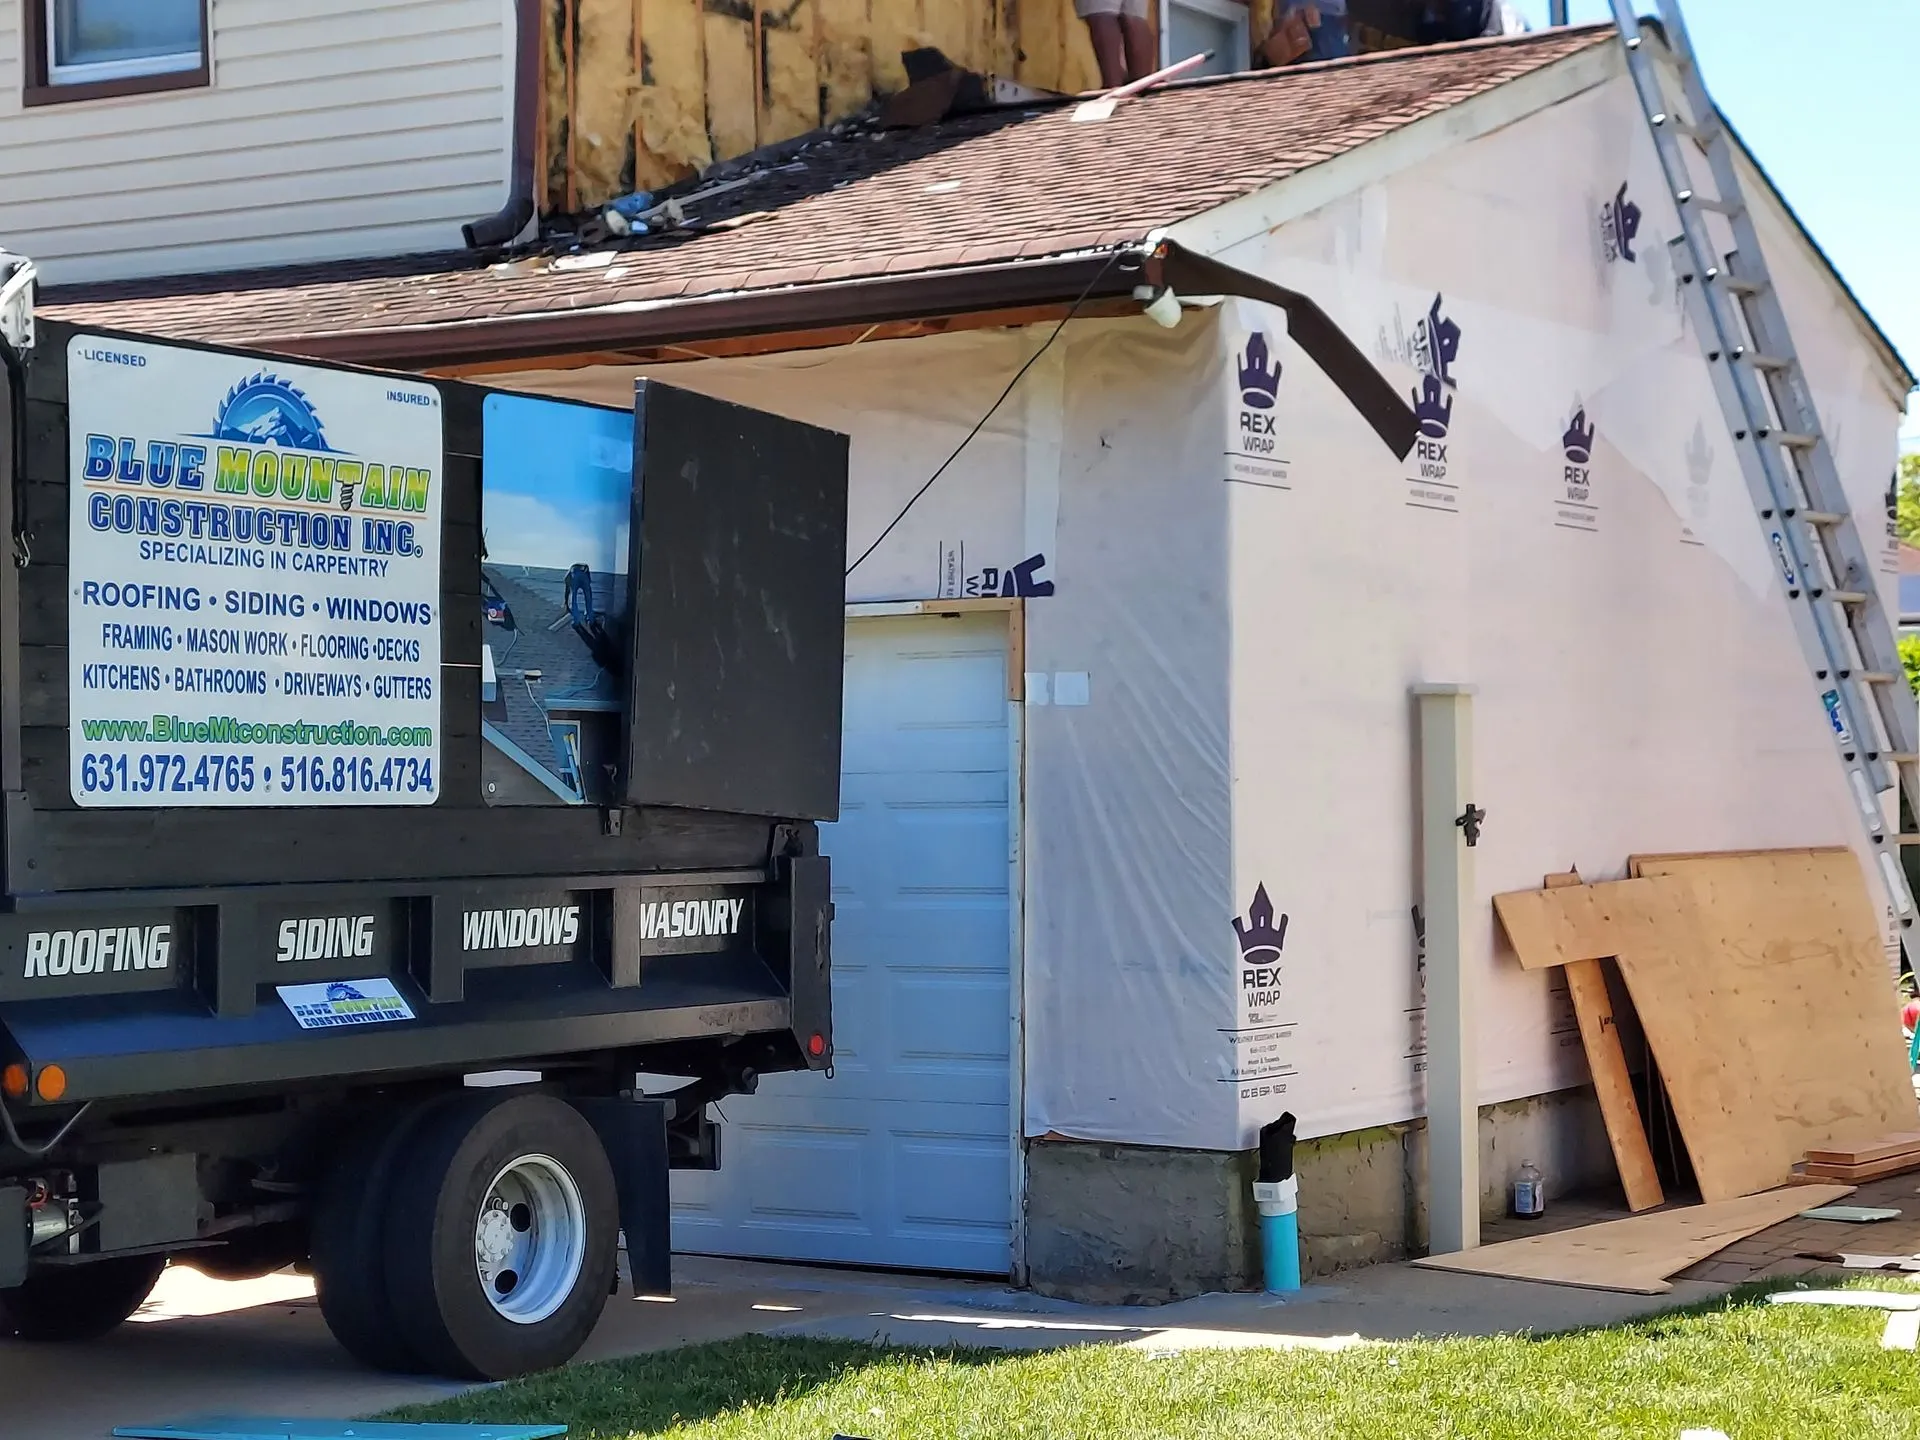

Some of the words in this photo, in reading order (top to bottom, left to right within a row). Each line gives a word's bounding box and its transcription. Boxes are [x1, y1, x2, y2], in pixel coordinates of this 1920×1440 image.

[83, 349, 147, 368] LICENSED
[386, 391, 431, 406] INSURED
[1240, 411, 1276, 436] REX
[1243, 436, 1275, 454] WRAP
[1417, 440, 1447, 464] REX
[82, 433, 206, 491] BLUE
[215, 446, 431, 513] MOUNTAIN
[1420, 463, 1447, 480] WRAP
[1564, 466, 1590, 487] REX
[88, 494, 352, 552] CONSTRUCTION
[362, 517, 424, 557] INC.
[139, 541, 265, 570] SPECIALIZING
[270, 553, 287, 571] IN
[292, 554, 389, 578] CARPENTRY
[82, 581, 201, 612] ROOFING
[225, 590, 305, 617] SIDING
[326, 597, 432, 625] WINDOWS
[102, 624, 173, 651] FRAMING
[186, 628, 240, 654] MASON
[244, 631, 289, 656] WORK
[301, 634, 369, 660] FLOORING
[377, 637, 420, 662] DECKS
[82, 664, 160, 692] KITCHENS
[174, 667, 267, 694] BATHROOMS
[283, 674, 362, 698] DRIVEWAYS
[373, 675, 432, 700] GUTTERS
[81, 715, 433, 747] www.BlueMtconstruction.com
[81, 753, 255, 792] 631.972.4765
[280, 756, 433, 792] 516.816.4734
[276, 915, 375, 963] SIDING
[463, 906, 580, 951] WINDOWS
[24, 924, 171, 979] ROOFING
[1243, 967, 1281, 989] REX
[1247, 990, 1281, 1008] WRAP
[304, 1013, 382, 1027] CONSTRUCTION
[383, 1009, 408, 1020] INC.
